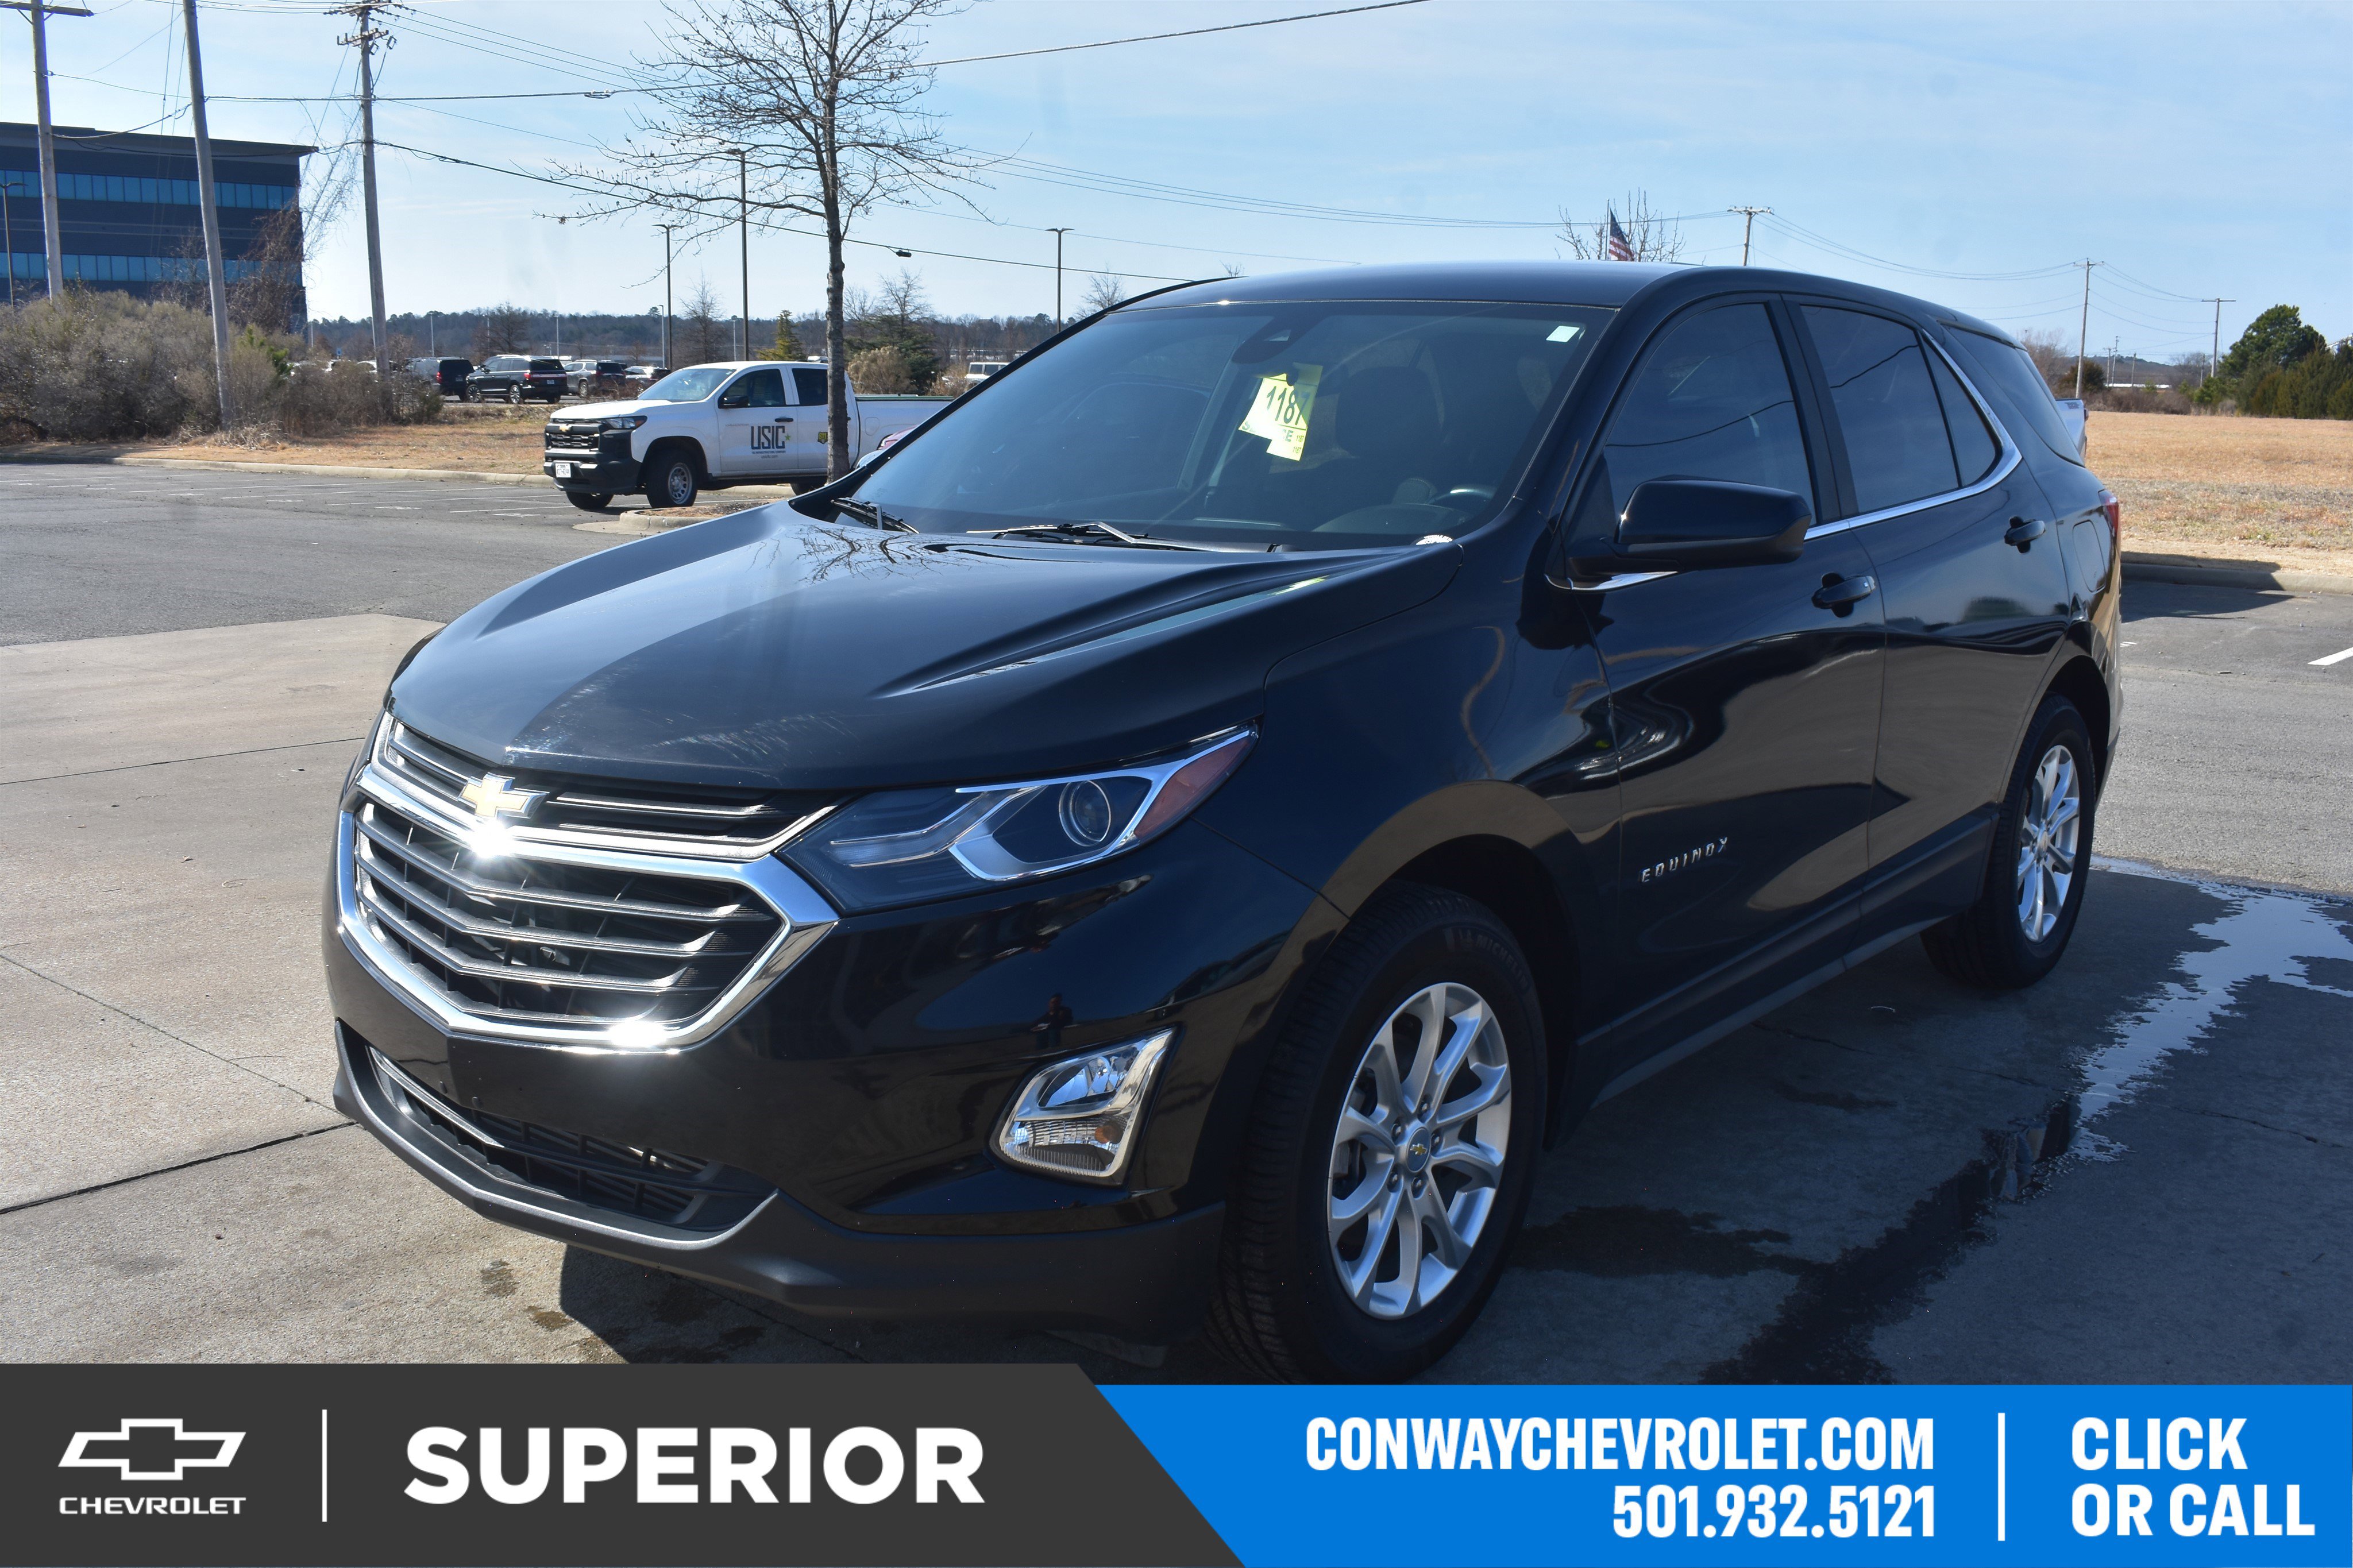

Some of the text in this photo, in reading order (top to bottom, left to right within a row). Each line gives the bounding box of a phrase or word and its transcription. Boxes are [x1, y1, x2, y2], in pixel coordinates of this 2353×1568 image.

[1266, 385, 1310, 426] 1187
[751, 426, 786, 450] USIC
[819, 432, 827, 440] 811
[1641, 836, 1728, 883] EQUINOX
[1475, 933, 1530, 991] MICHELIN
